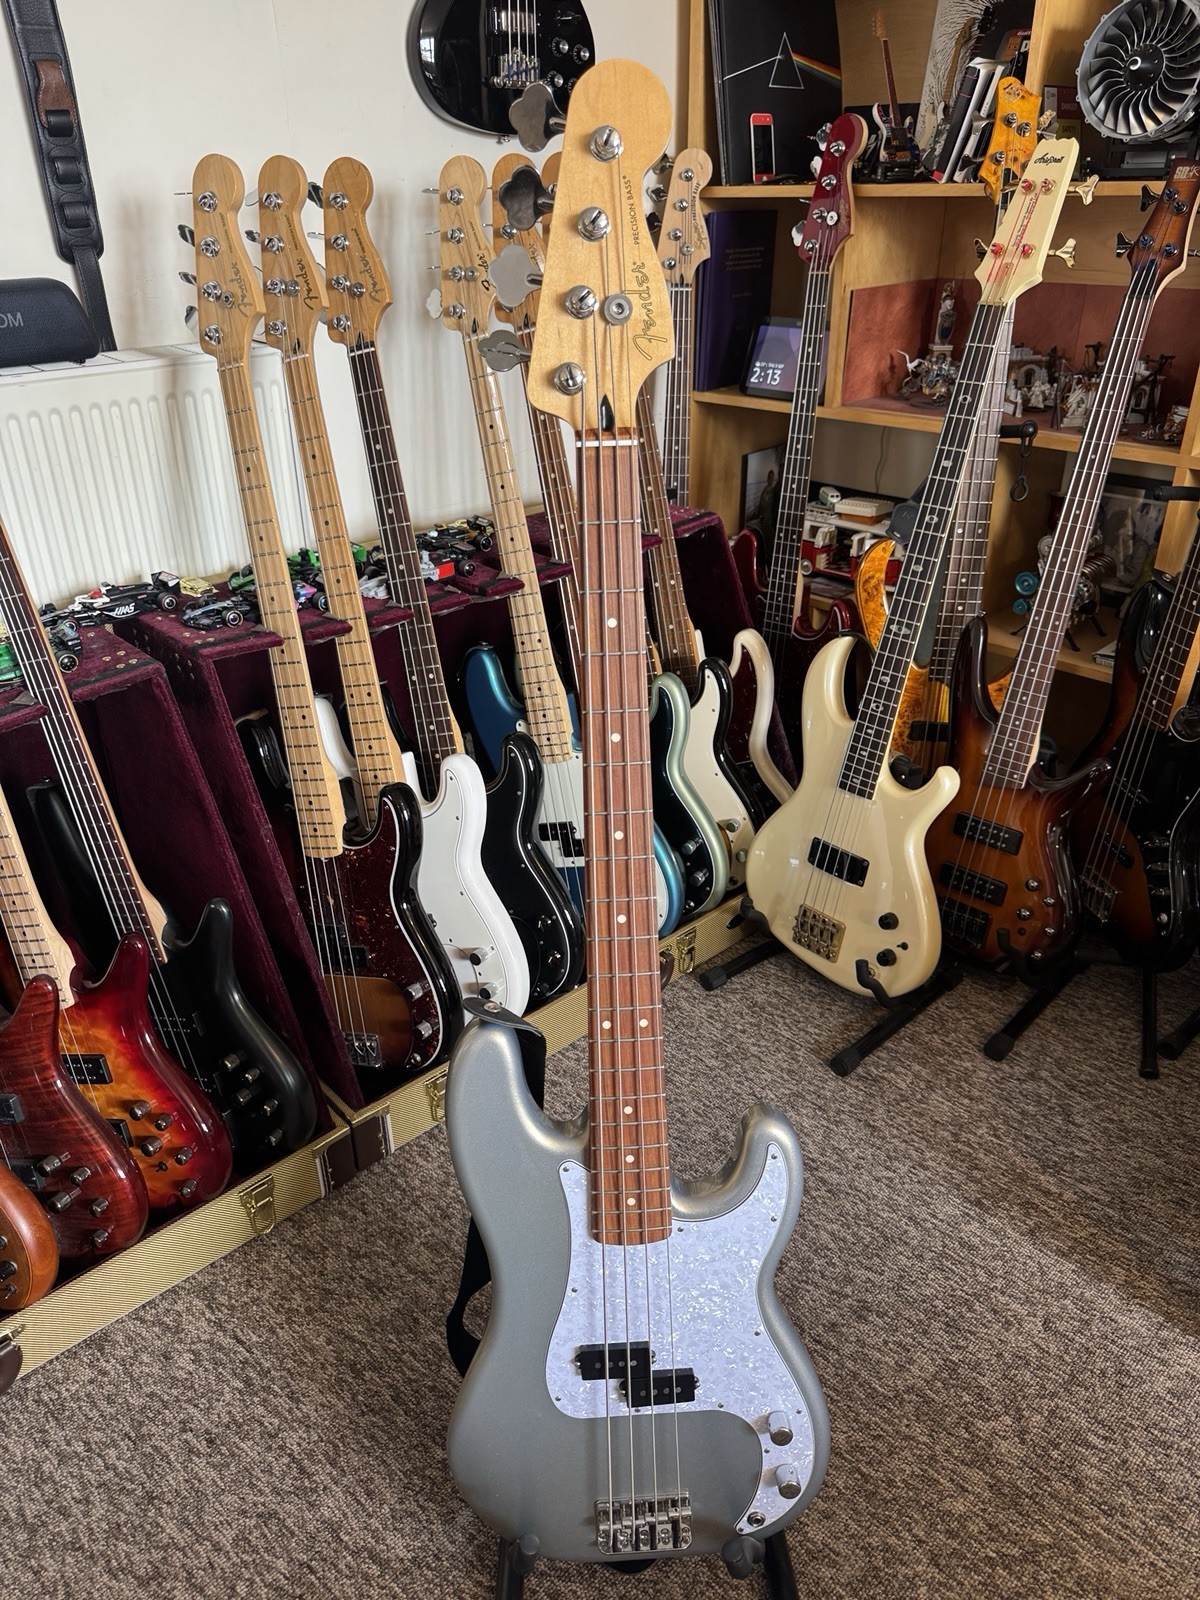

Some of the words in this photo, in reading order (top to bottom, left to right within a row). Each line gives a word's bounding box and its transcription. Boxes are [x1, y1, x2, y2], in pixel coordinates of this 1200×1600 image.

[630, 203, 641, 245] PRECISION
[229, 261, 253, 318] Fender
[295, 258, 319, 311] Fender
[359, 254, 385, 303] Fender
[622, 262, 668, 361] Fender
[750, 367, 782, 385] 2:13
